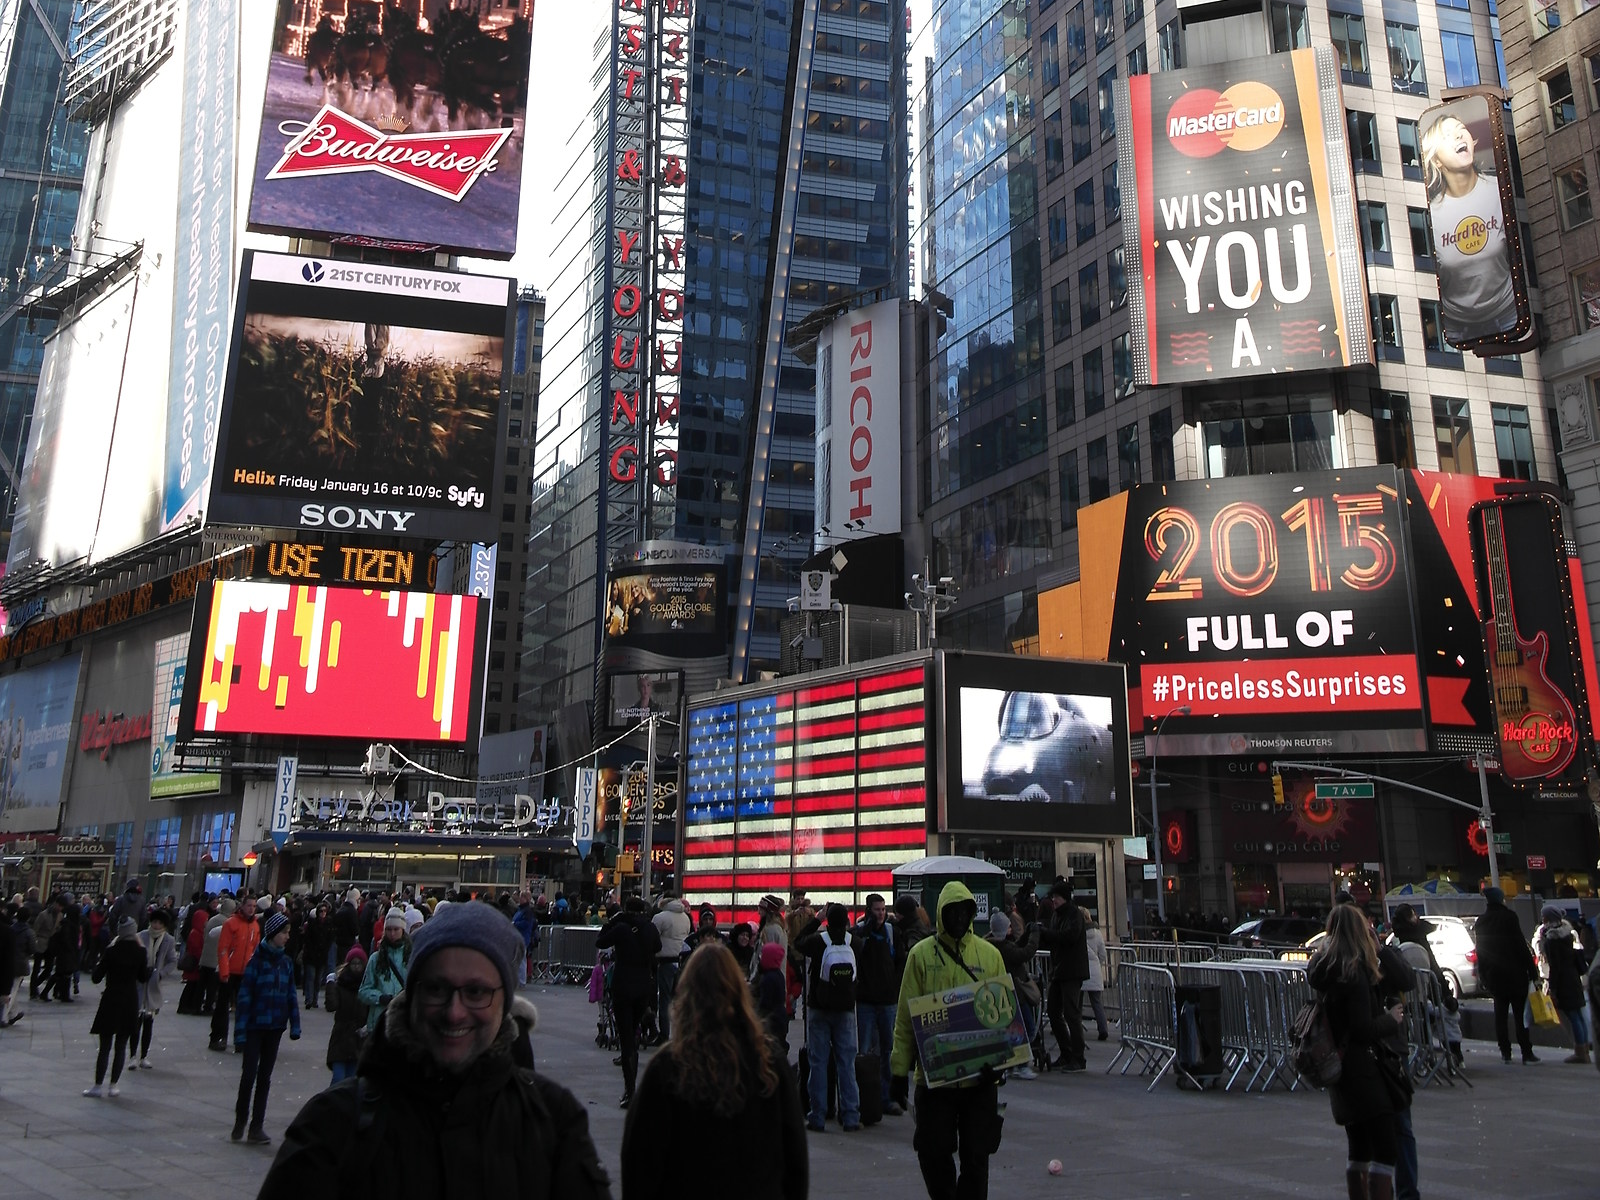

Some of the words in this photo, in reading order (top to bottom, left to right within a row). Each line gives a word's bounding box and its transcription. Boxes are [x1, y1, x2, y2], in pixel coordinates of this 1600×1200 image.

[1168, 102, 1281, 137] MasterCard
[278, 120, 498, 176] Budweiser
[617, 150, 641, 181] &
[1159, 180, 1307, 230] WISHING
[1441, 225, 1469, 247] Hard
[1471, 216, 1499, 237] Rock
[1466, 240, 1480, 249] CAFE
[205, 194, 224, 314] Healthy
[1166, 224, 1312, 314] YOU
[330, 269, 363, 283] 21ST
[364, 273, 433, 290] CENTURY
[434, 280, 461, 293] FOX
[609, 230, 640, 483] YOUNG
[1231, 318, 1261, 368] A
[202, 322, 220, 465] Choices
[850, 320, 872, 521] RICOH
[234, 469, 275, 485] Helix
[279, 474, 317, 491] Friday
[321, 479, 370, 496] January
[373, 482, 388, 494] 16
[392, 484, 403, 495] at
[407, 485, 441, 498] 10/9c
[447, 485, 485, 508] Syfy
[300, 504, 415, 531] SONY
[204, 531, 260, 543] SHERWOOD
[1143, 490, 1399, 600] 2015
[267, 543, 323, 578] USE
[340, 547, 414, 585] TIZEN
[647, 548, 723, 560] NBCUNIVERSAL
[650, 603, 682, 612] GOLDEN
[683, 603, 712, 611] GLOBE
[670, 595, 687, 603] 2015
[663, 611, 696, 619] AWARDS
[1186, 613, 1288, 652] FULL
[1295, 610, 1354, 647] OF
[1152, 670, 1407, 704] #PricelessSurprises
[1251, 739, 1292, 748] THOMSON
[1294, 738, 1332, 747] REUTERS
[1503, 722, 1536, 741] Hard
[1538, 721, 1573, 742] Rock
[185, 747, 230, 757] SHERWOOD
[1530, 744, 1550, 752] CAFE
[276, 760, 294, 829] NYPD
[581, 771, 594, 837] NYPD
[605, 784, 645, 797] GOEN
[1332, 786, 1339, 795] 7
[1342, 786, 1356, 795] Av
[297, 790, 348, 820] NEW
[356, 790, 417, 823] YORK
[427, 791, 504, 822] POLICE
[57, 840, 104, 853] nuchas
[987, 858, 1012, 868] ARMED
[1014, 858, 1042, 868] FORCES
[1005, 871, 1033, 879] CENTER
[920, 1009, 949, 1026] FREE
[974, 986, 1013, 1024] $34
